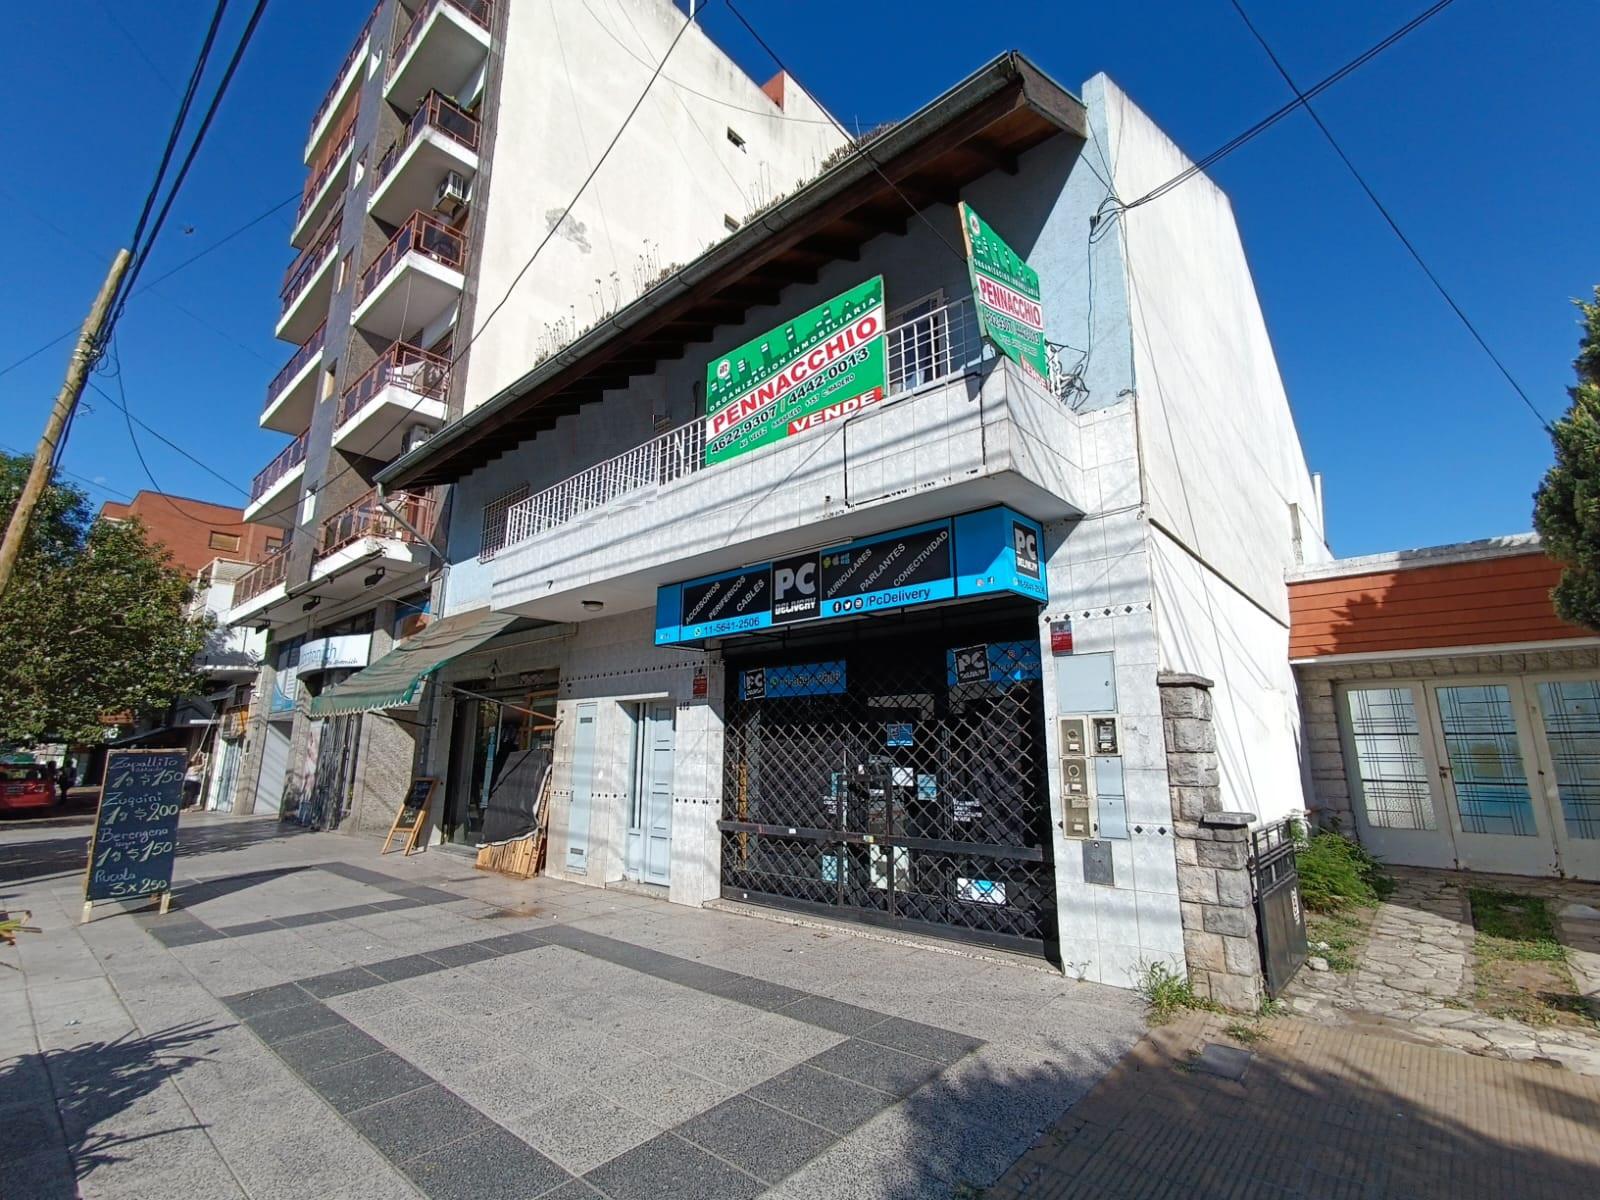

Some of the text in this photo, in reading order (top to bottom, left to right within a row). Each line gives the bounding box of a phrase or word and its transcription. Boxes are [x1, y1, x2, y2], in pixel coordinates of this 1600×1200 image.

[979, 278, 1040, 326] PENNACCHIO
[709, 297, 876, 411] ORGANIZACION INMOBILIARIA
[712, 316, 877, 434] PENNACCHIO
[711, 405, 777, 454] 4622-9307
[787, 347, 869, 405] 4442-0013
[791, 390, 880, 433] VENDE
[893, 530, 949, 587] CONECTIVIDAD
[1014, 528, 1038, 561] PC
[775, 562, 816, 600] PC
[826, 548, 872, 598] AURICULARES
[859, 543, 906, 592] PARLANTES
[685, 582, 720, 625] ACCESORIOS
[708, 575, 746, 620] PERIFERICOS
[736, 579, 765, 612] CABLES
[775, 597, 817, 616] DELIVERY
[704, 617, 760, 635] 11-5641-2506
